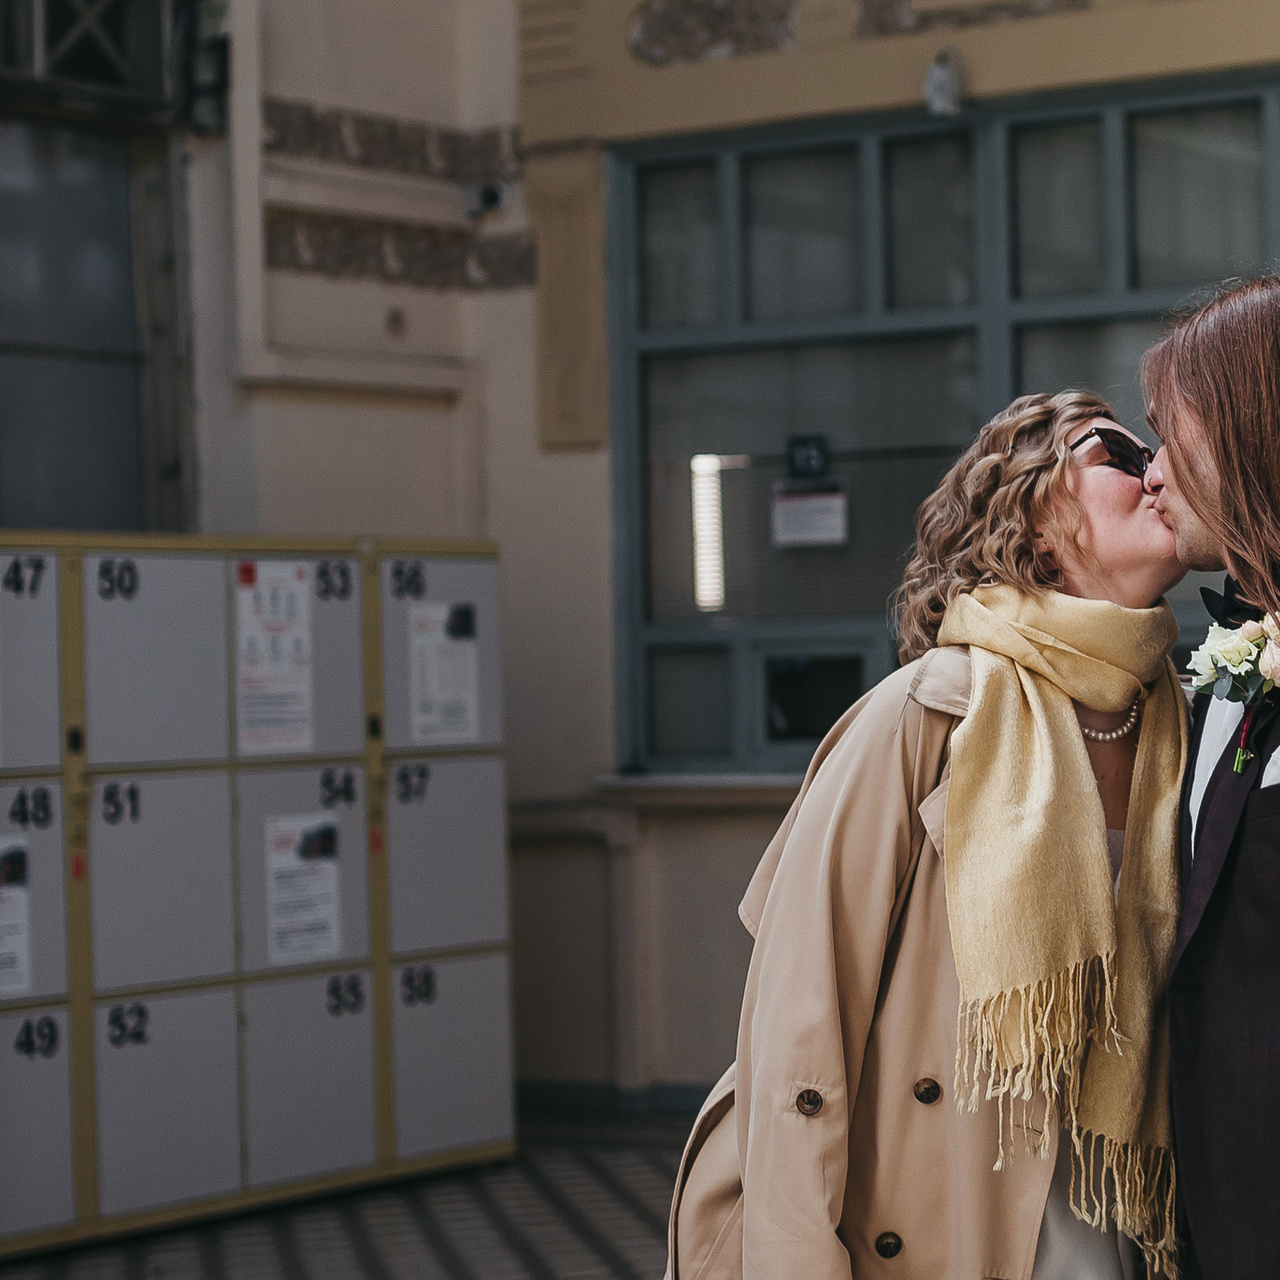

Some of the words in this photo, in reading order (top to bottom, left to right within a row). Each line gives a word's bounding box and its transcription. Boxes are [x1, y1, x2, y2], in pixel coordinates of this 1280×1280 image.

[3, 554, 46, 598] 47
[98, 557, 139, 600] 50
[315, 559, 352, 600] 53
[391, 559, 426, 600] 56
[9, 787, 53, 829] 48
[103, 782, 141, 825] 51
[321, 768, 357, 807] 54
[328, 973, 365, 1016] 55
[14, 1017, 59, 1058] 49
[108, 1002, 149, 1047] 52
